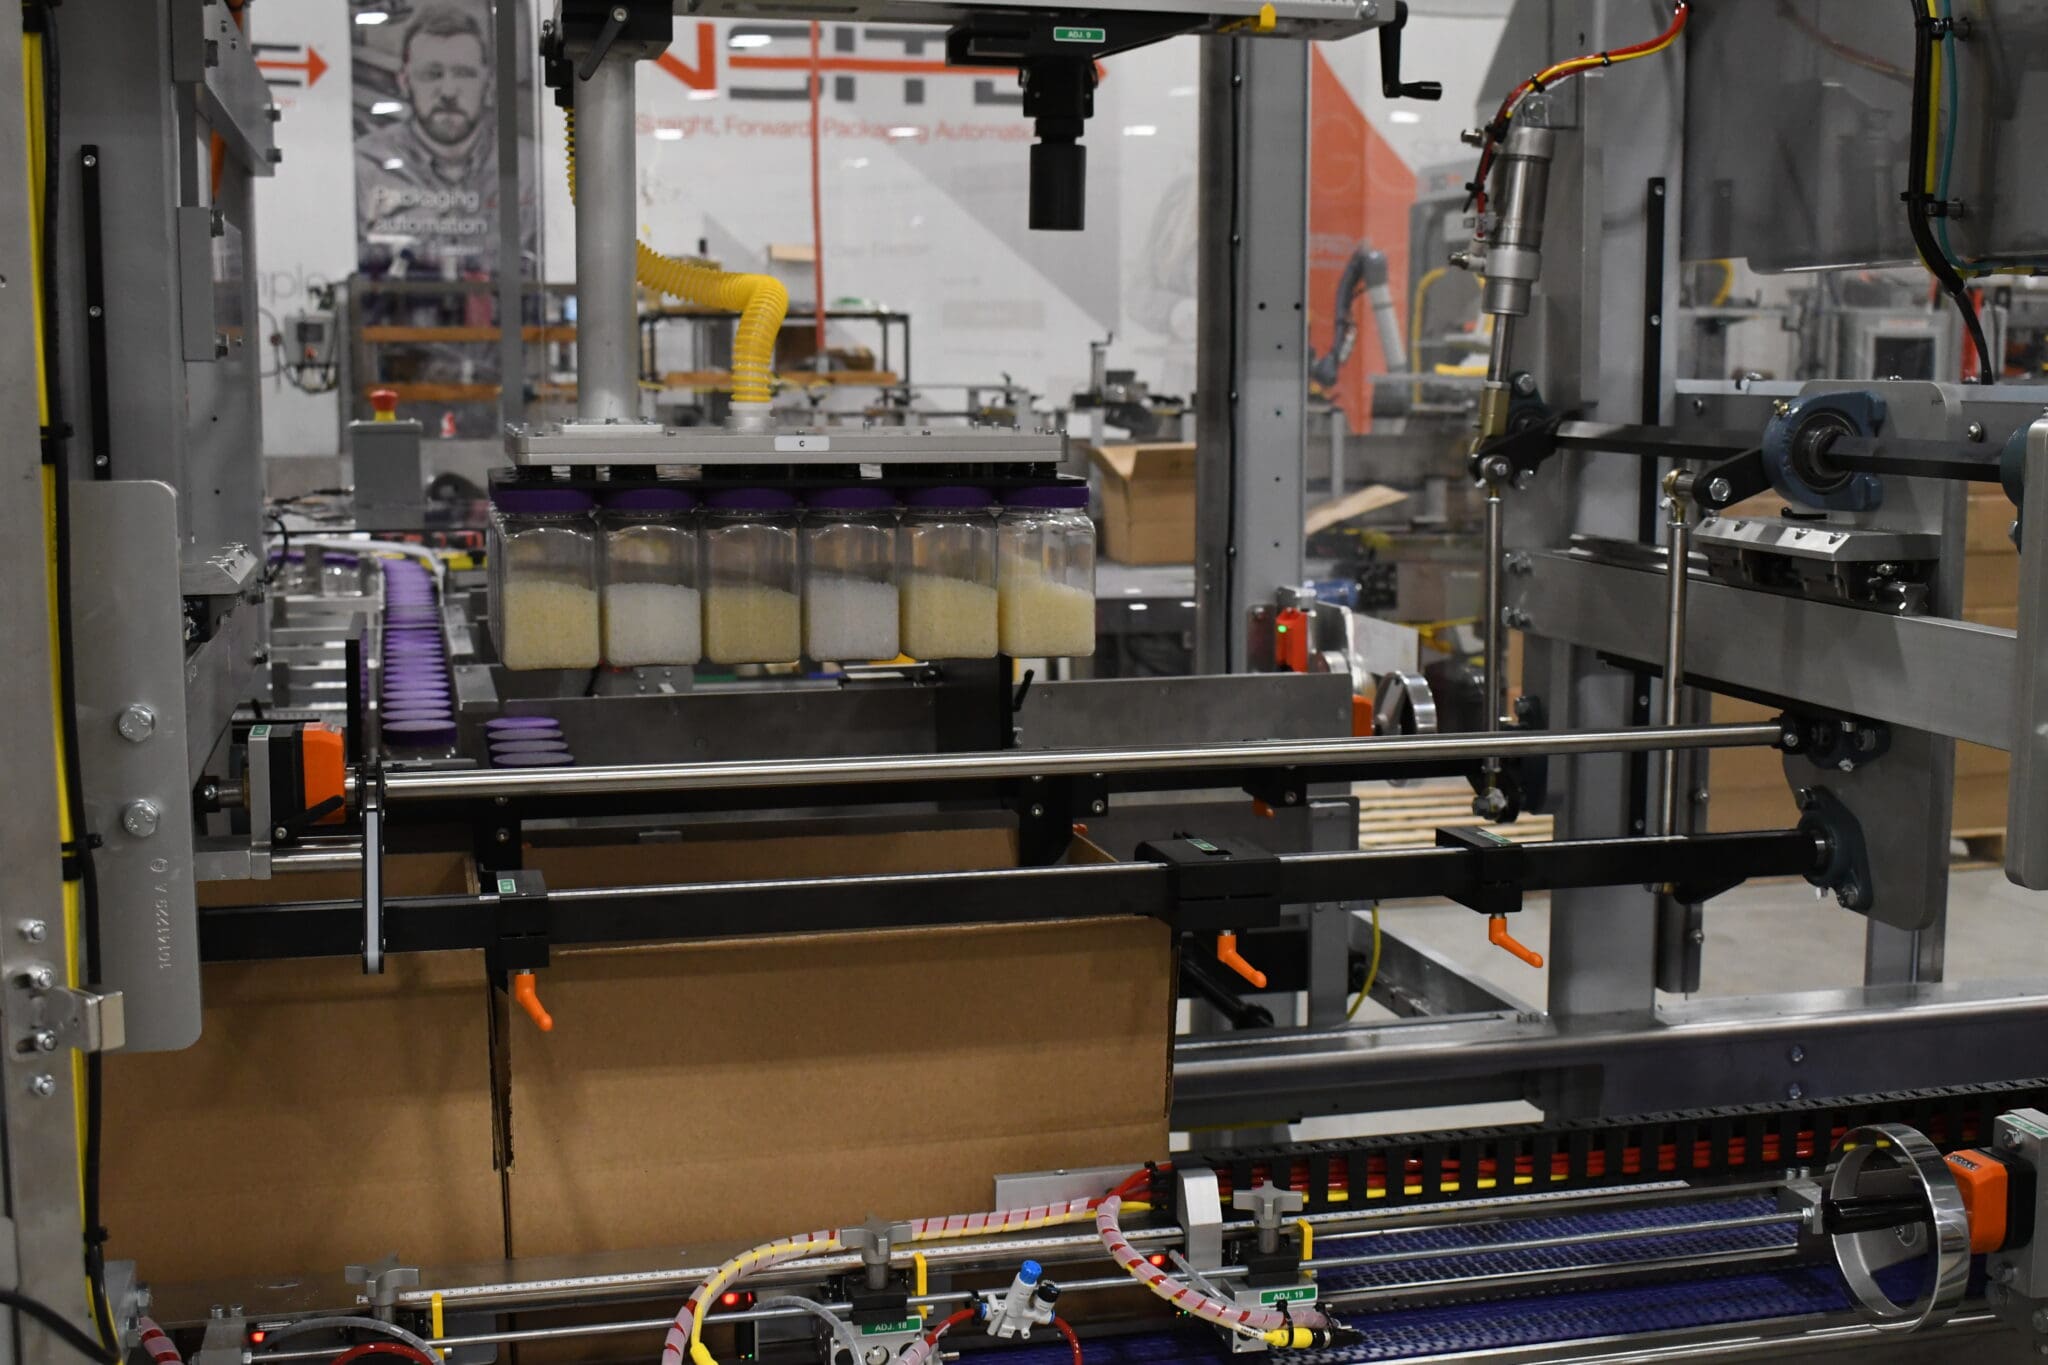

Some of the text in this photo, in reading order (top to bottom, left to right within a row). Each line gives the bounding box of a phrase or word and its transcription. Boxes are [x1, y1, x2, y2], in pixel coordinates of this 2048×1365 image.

[824, 116, 929, 144] Packagg
[1273, 1290, 1304, 1300] ADJ. 19
[875, 1321, 907, 1331] ADJ. 18
